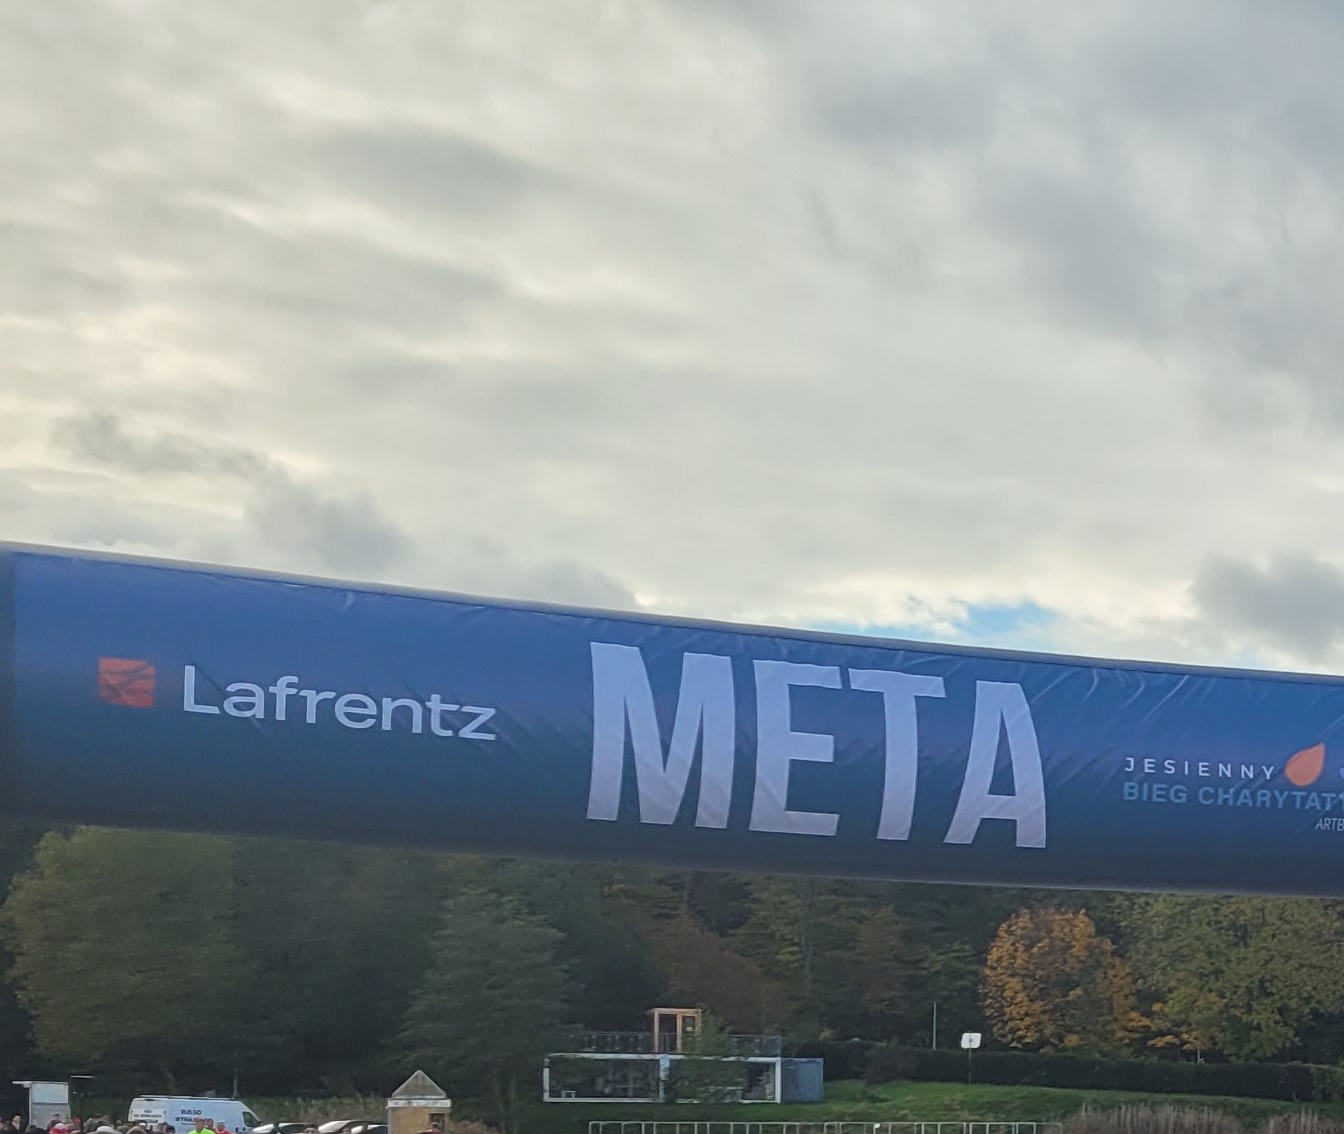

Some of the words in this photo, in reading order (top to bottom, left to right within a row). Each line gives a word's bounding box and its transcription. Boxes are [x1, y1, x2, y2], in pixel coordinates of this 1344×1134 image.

[182, 664, 497, 741] Lafrentz
[586, 642, 1047, 849] META
[1124, 757, 1275, 781] JESIENNY
[1123, 782, 1188, 804] BIEG
